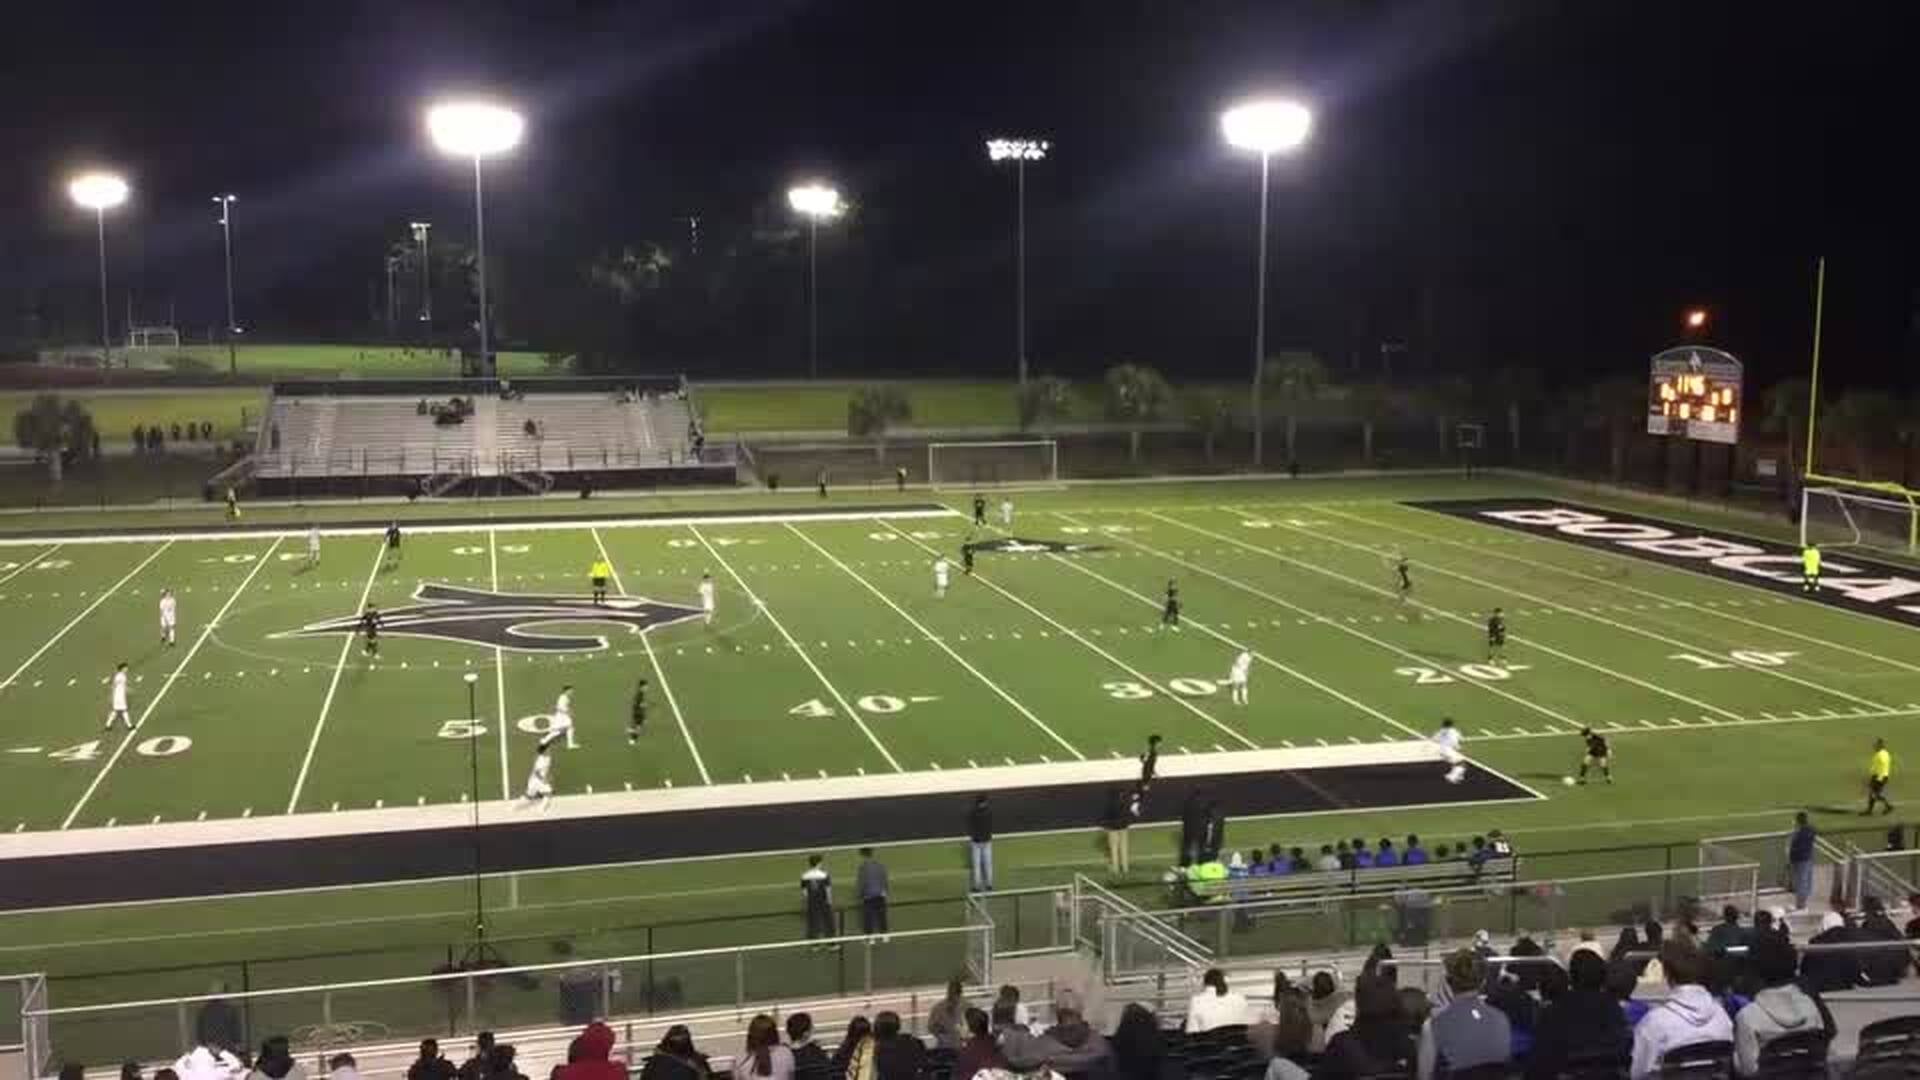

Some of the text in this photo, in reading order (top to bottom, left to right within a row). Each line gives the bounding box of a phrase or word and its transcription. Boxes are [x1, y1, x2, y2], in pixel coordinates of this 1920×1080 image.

[1478, 508, 1920, 614] BOBCA
[1668, 649, 1787, 669] 10
[1393, 663, 1511, 684] 20
[1102, 677, 1217, 699] 30
[787, 694, 906, 718] 40
[47, 735, 193, 762] 40
